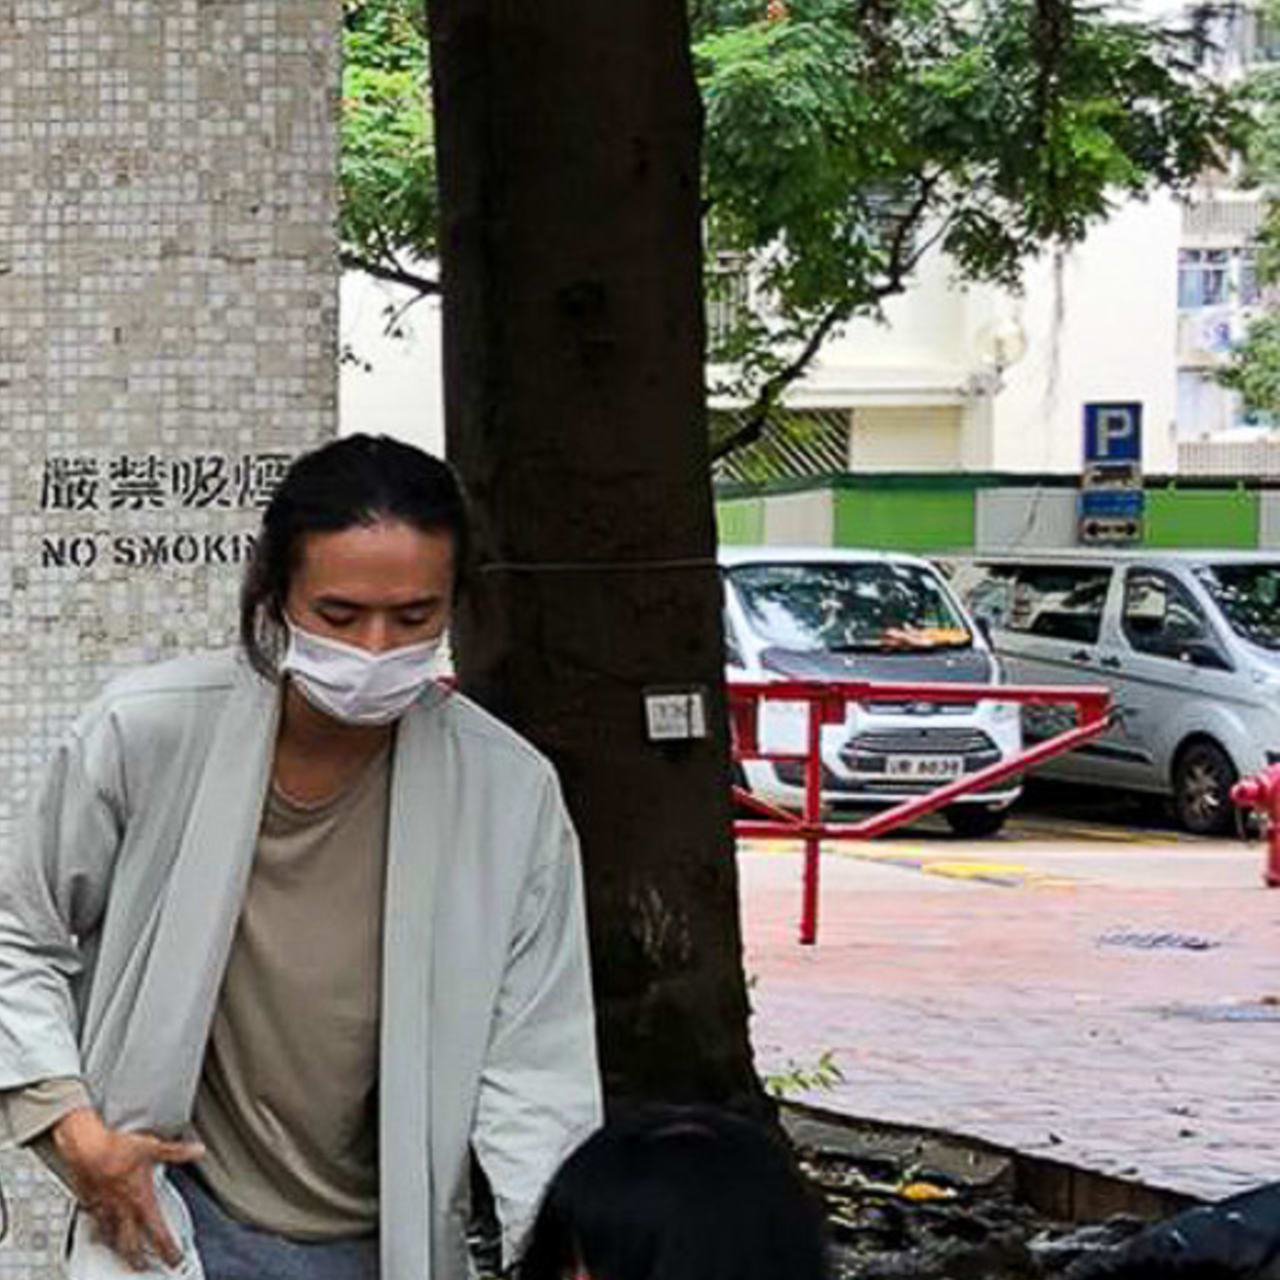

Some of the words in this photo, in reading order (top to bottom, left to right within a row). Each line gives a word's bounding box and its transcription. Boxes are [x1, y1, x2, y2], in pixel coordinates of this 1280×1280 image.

[1096, 408, 1133, 457] P
[41, 453, 292, 511] 嚴禁吸煙
[42, 537, 97, 568] NO
[112, 533, 260, 567] SMOKIN
